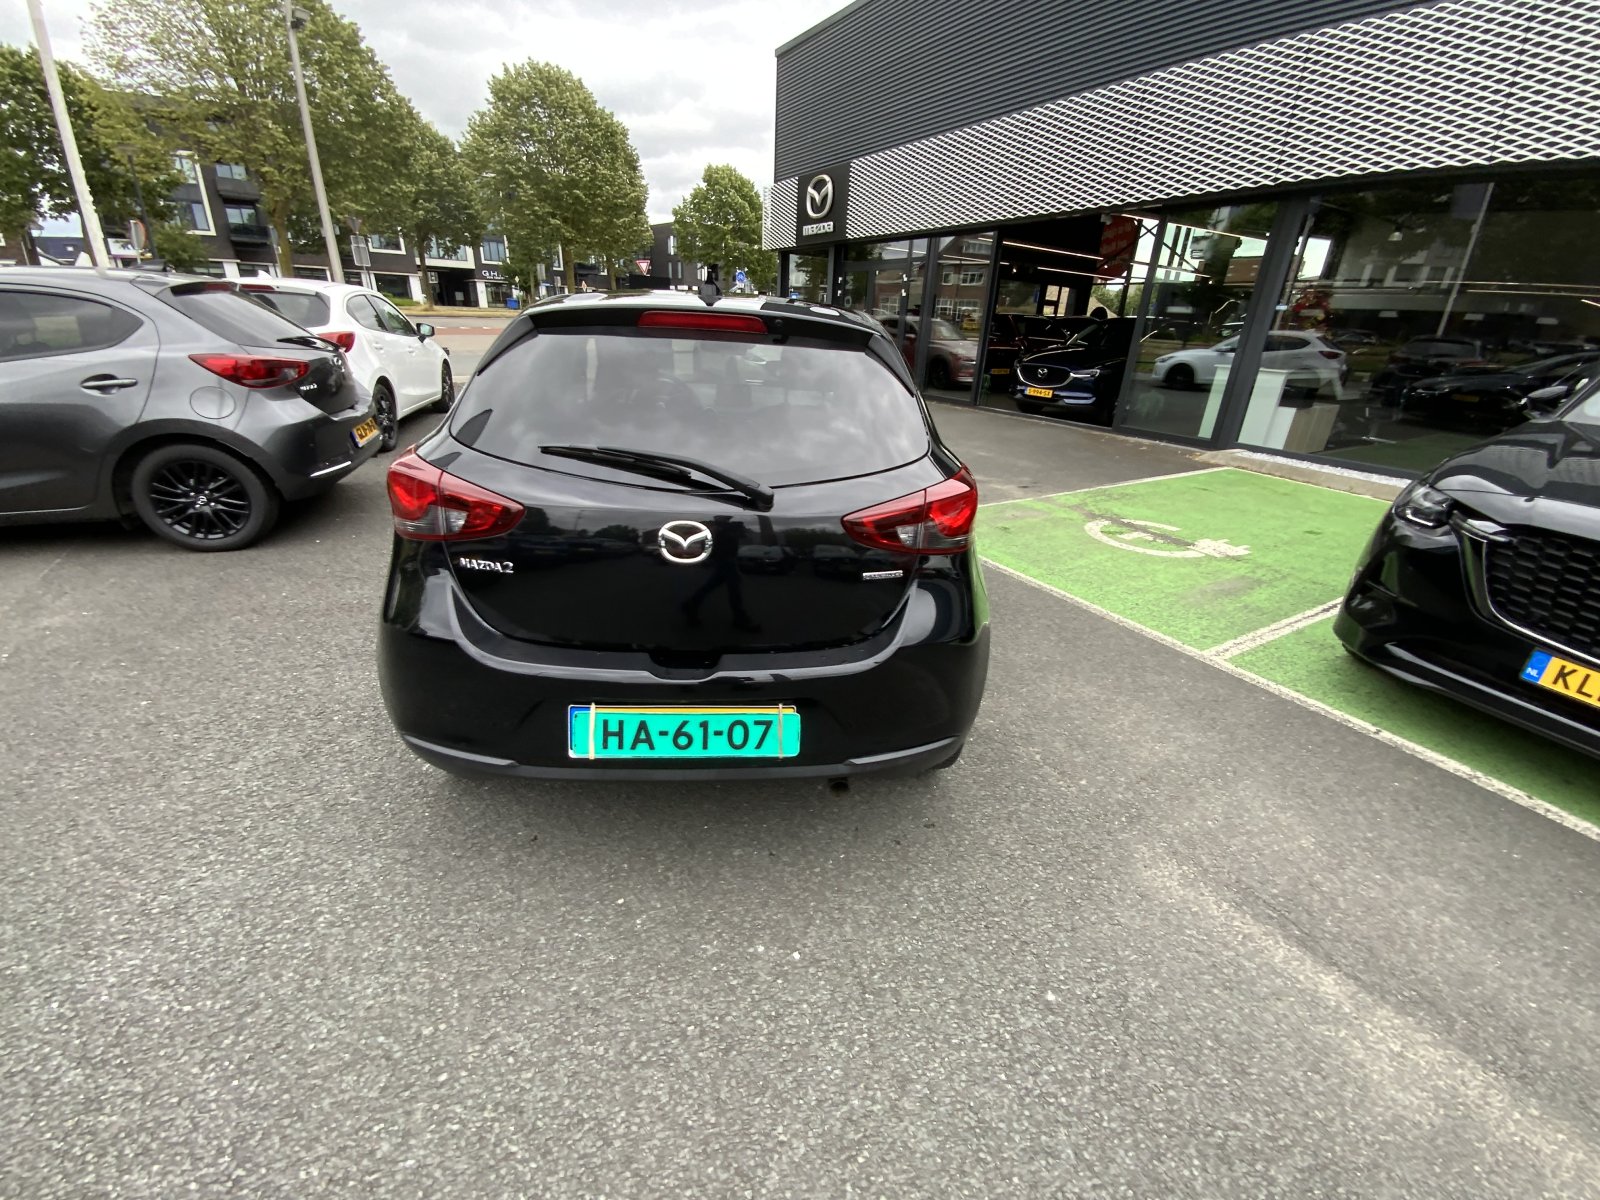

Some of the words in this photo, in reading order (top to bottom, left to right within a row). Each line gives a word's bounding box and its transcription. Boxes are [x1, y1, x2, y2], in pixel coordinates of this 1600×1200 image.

[1526, 667, 1539, 678] NL
[1552, 665, 1600, 702] KL
[602, 719, 773, 751] HA-61-07
